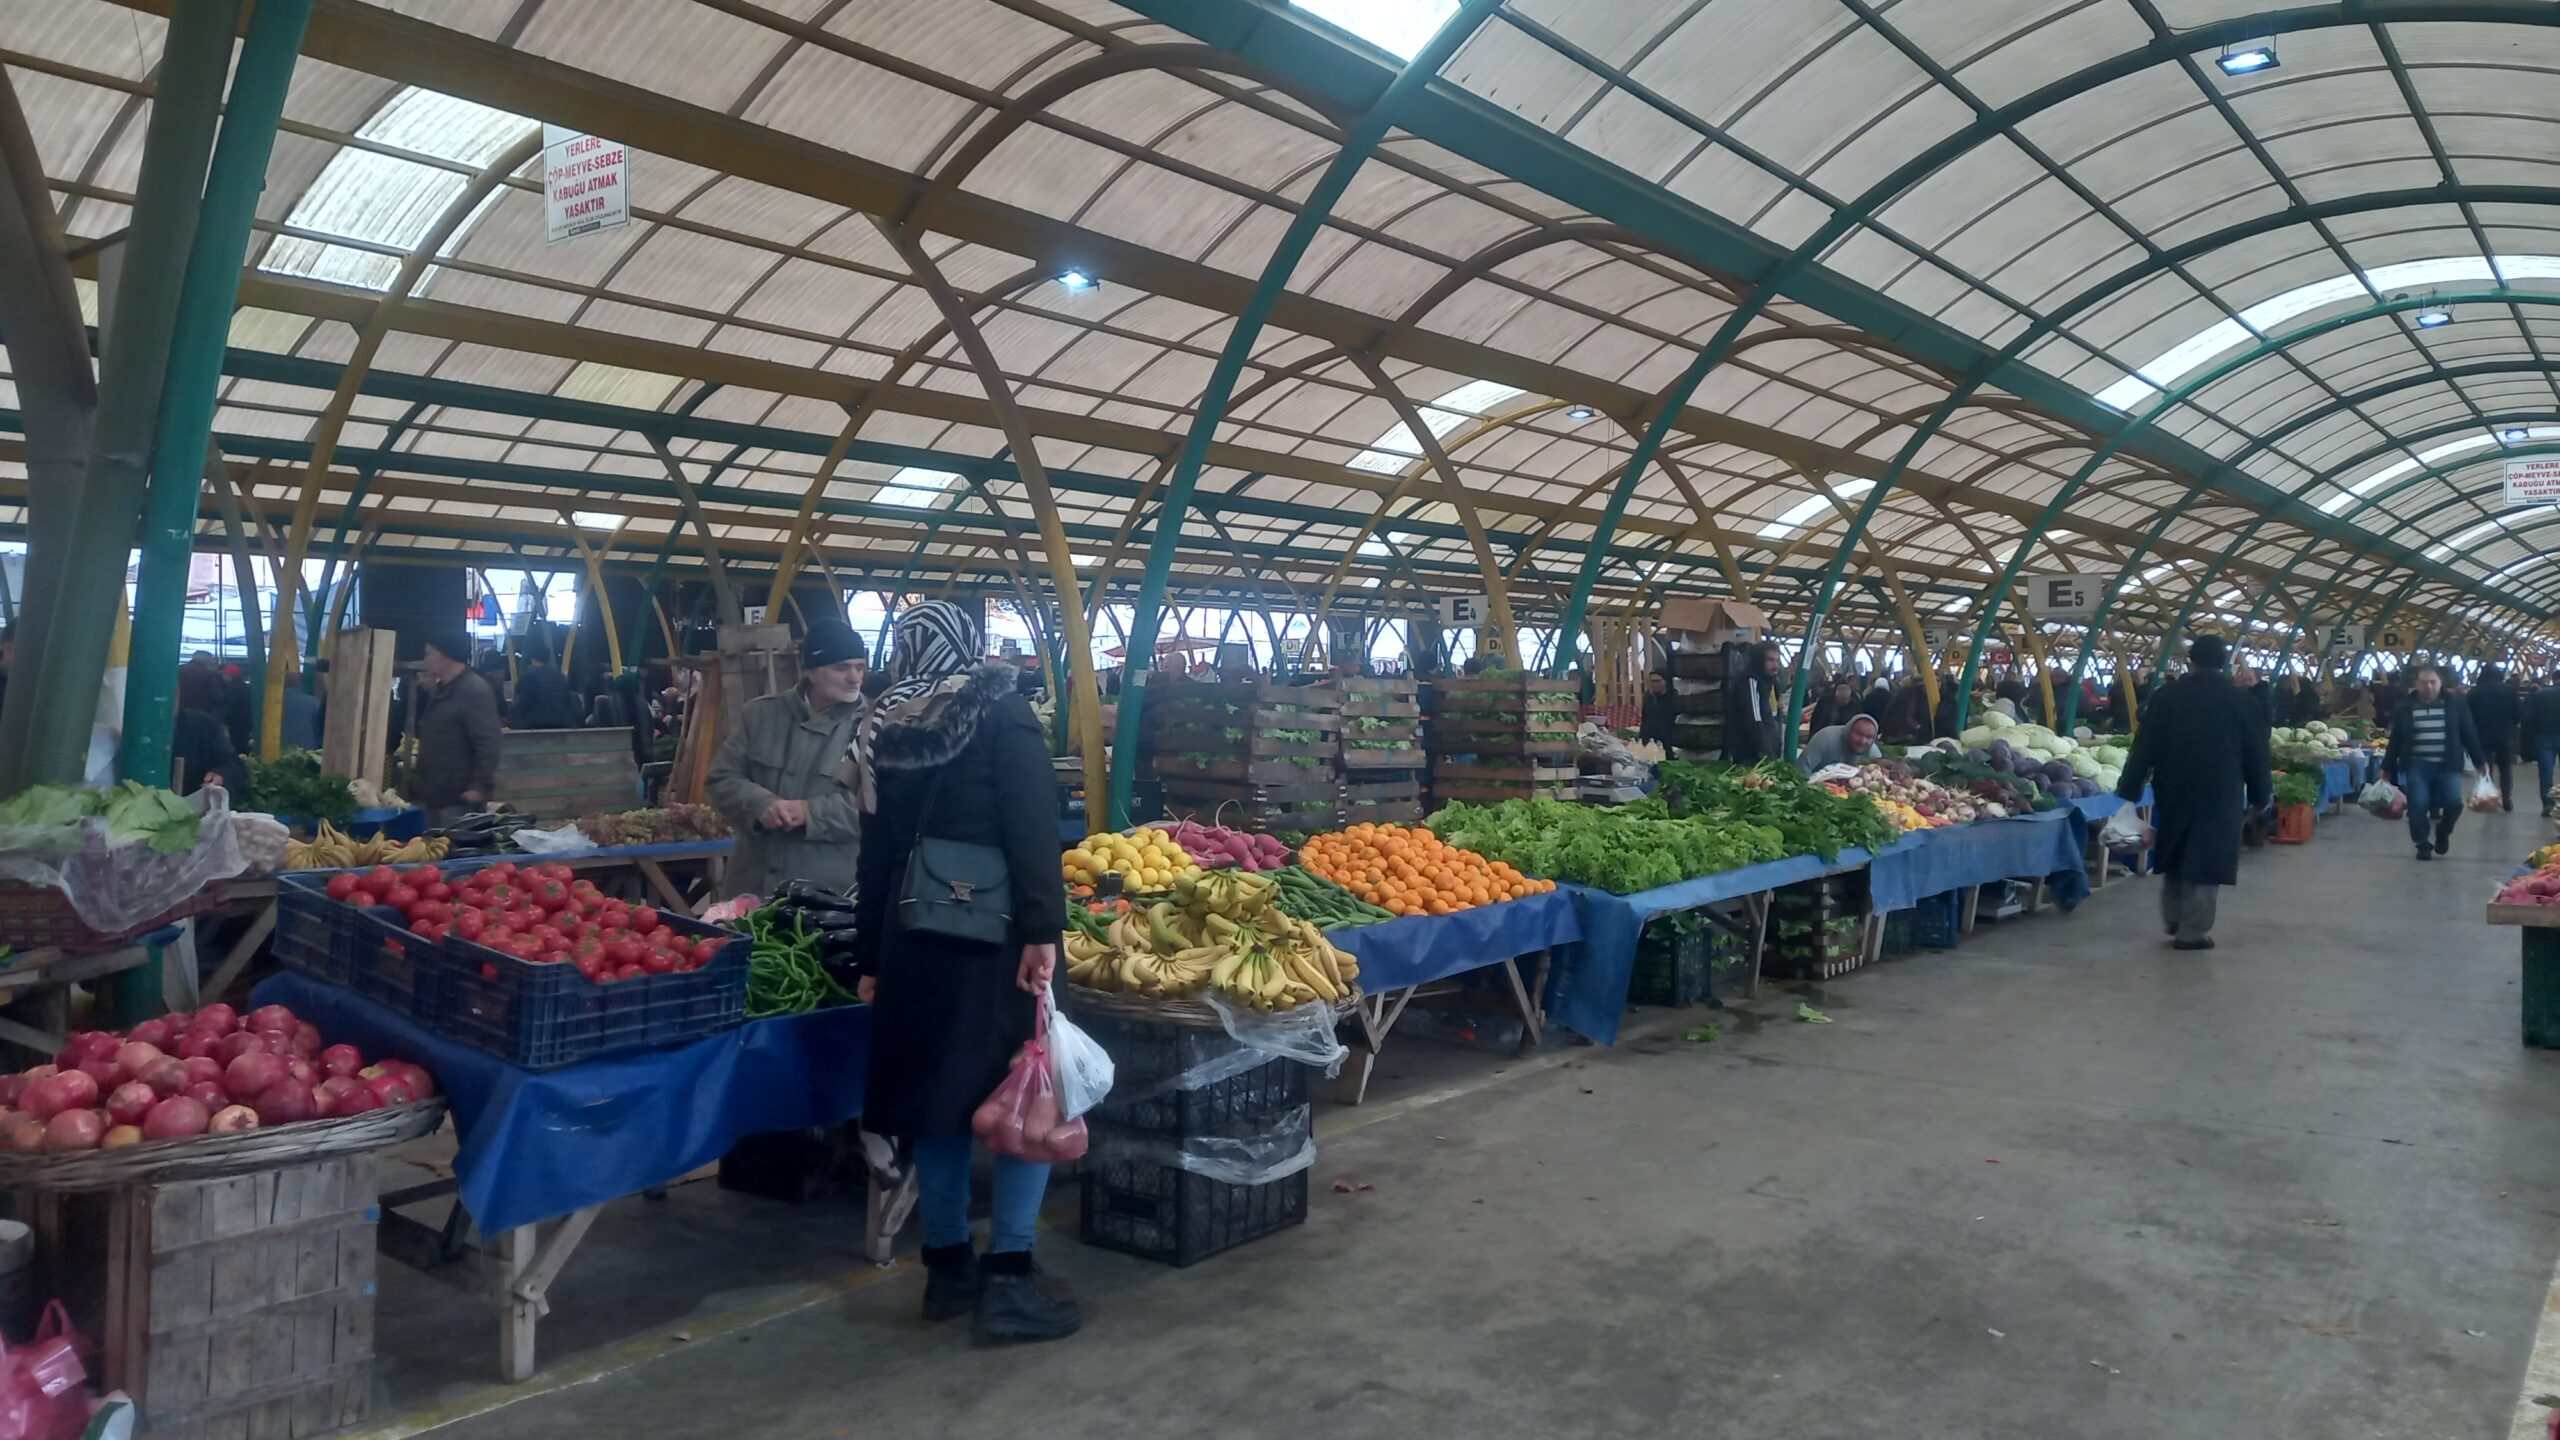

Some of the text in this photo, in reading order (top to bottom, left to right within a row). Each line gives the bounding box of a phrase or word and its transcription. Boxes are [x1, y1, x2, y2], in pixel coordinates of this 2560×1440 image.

[565, 137, 601, 158] YERLERE
[553, 172, 618, 204] KABUĞU ATMAK
[564, 196, 605, 220] YASAKTIR
[2526, 462, 2559, 470] YERLERE
[2048, 580, 2084, 608] E5
[1453, 598, 1477, 621] E4
